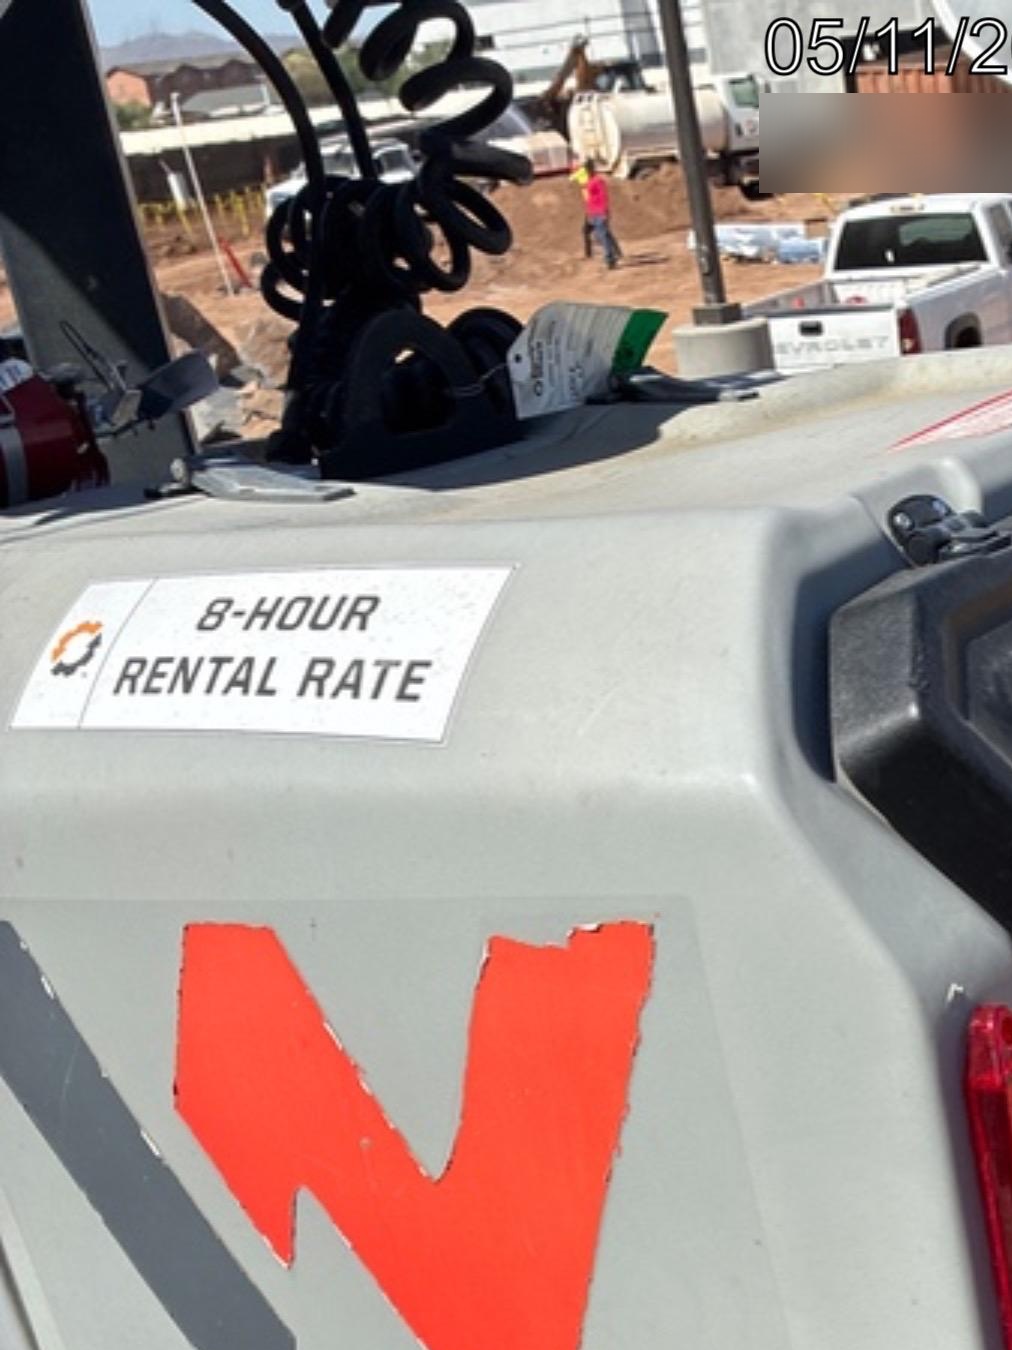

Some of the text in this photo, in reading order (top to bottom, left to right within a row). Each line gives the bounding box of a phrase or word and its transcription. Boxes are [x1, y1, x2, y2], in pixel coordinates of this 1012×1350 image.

[197, 595, 381, 631] 8-HOUR
[113, 656, 432, 702] RENTAL RATE
